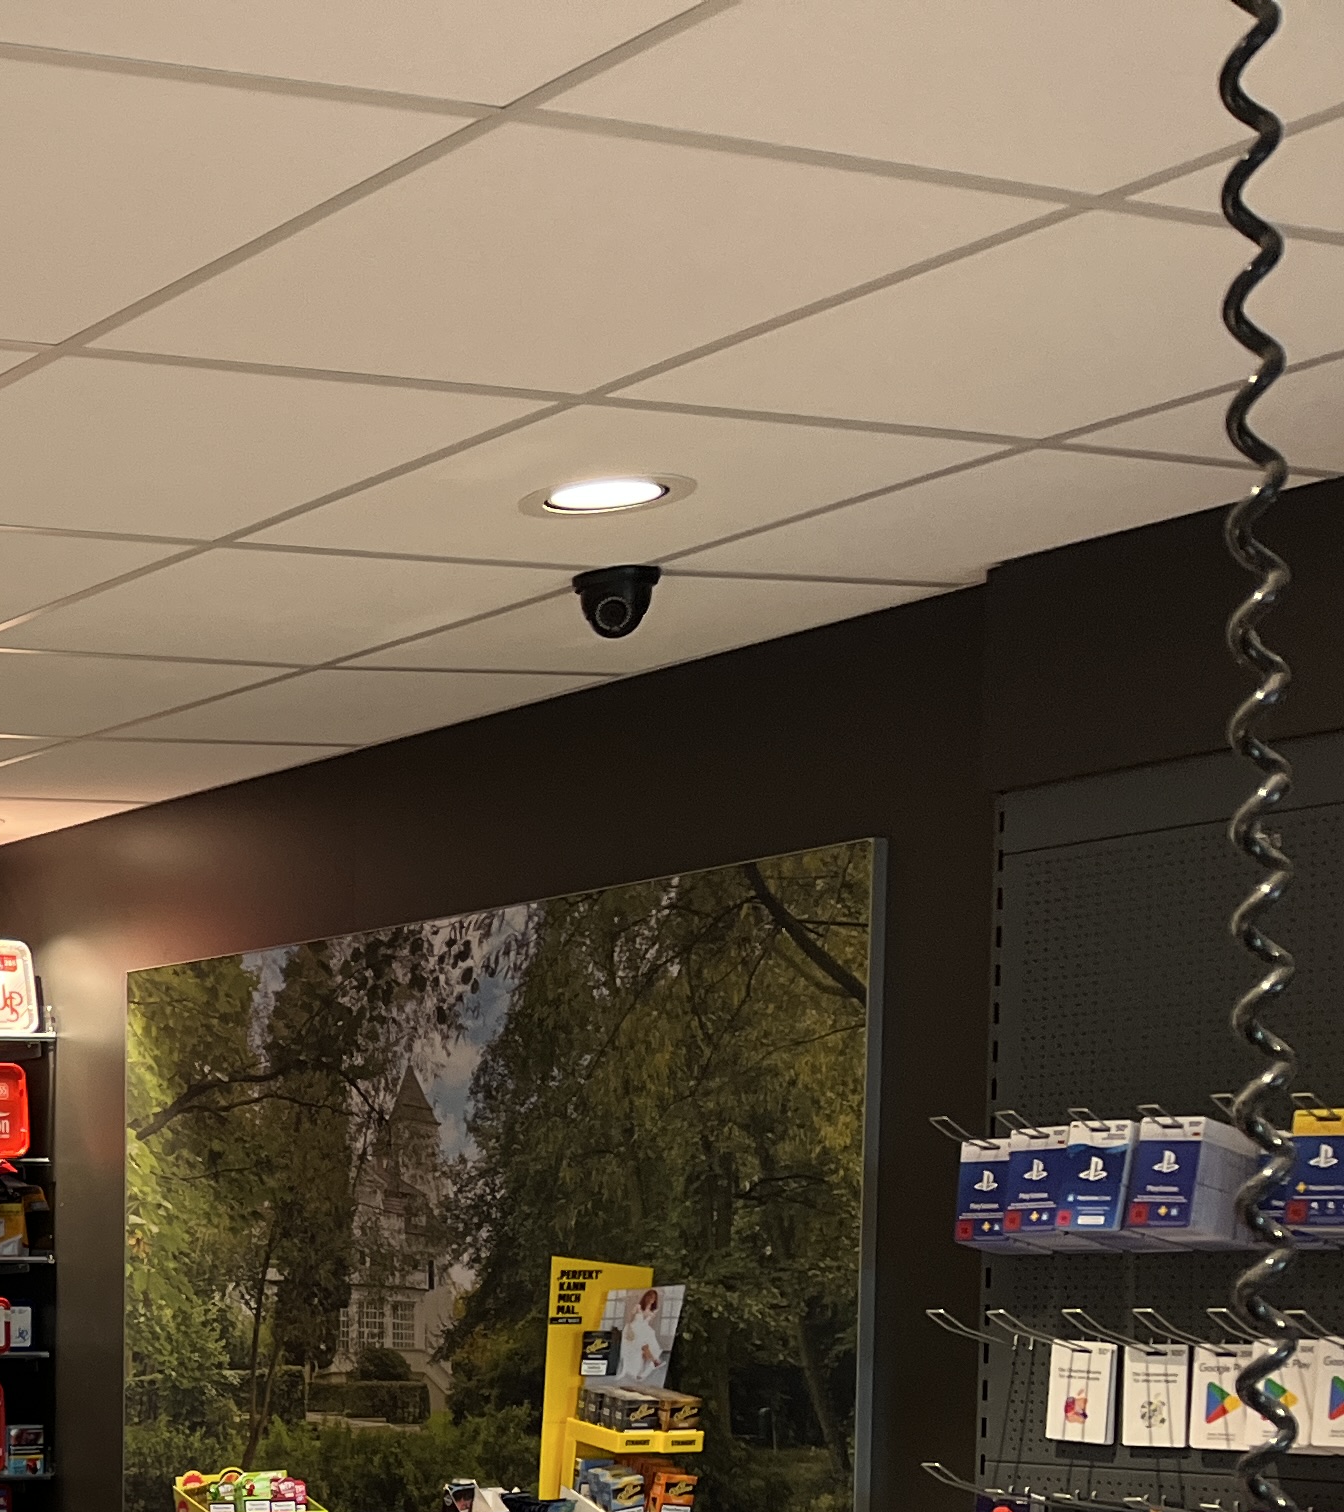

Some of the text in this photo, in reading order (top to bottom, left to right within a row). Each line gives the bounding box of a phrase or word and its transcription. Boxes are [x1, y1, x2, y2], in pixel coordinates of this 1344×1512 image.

[559, 1282, 585, 1291] KANN
[558, 1294, 580, 1303] MICH
[557, 1306, 579, 1315] MAL.
[1199, 1362, 1234, 1374] Google
